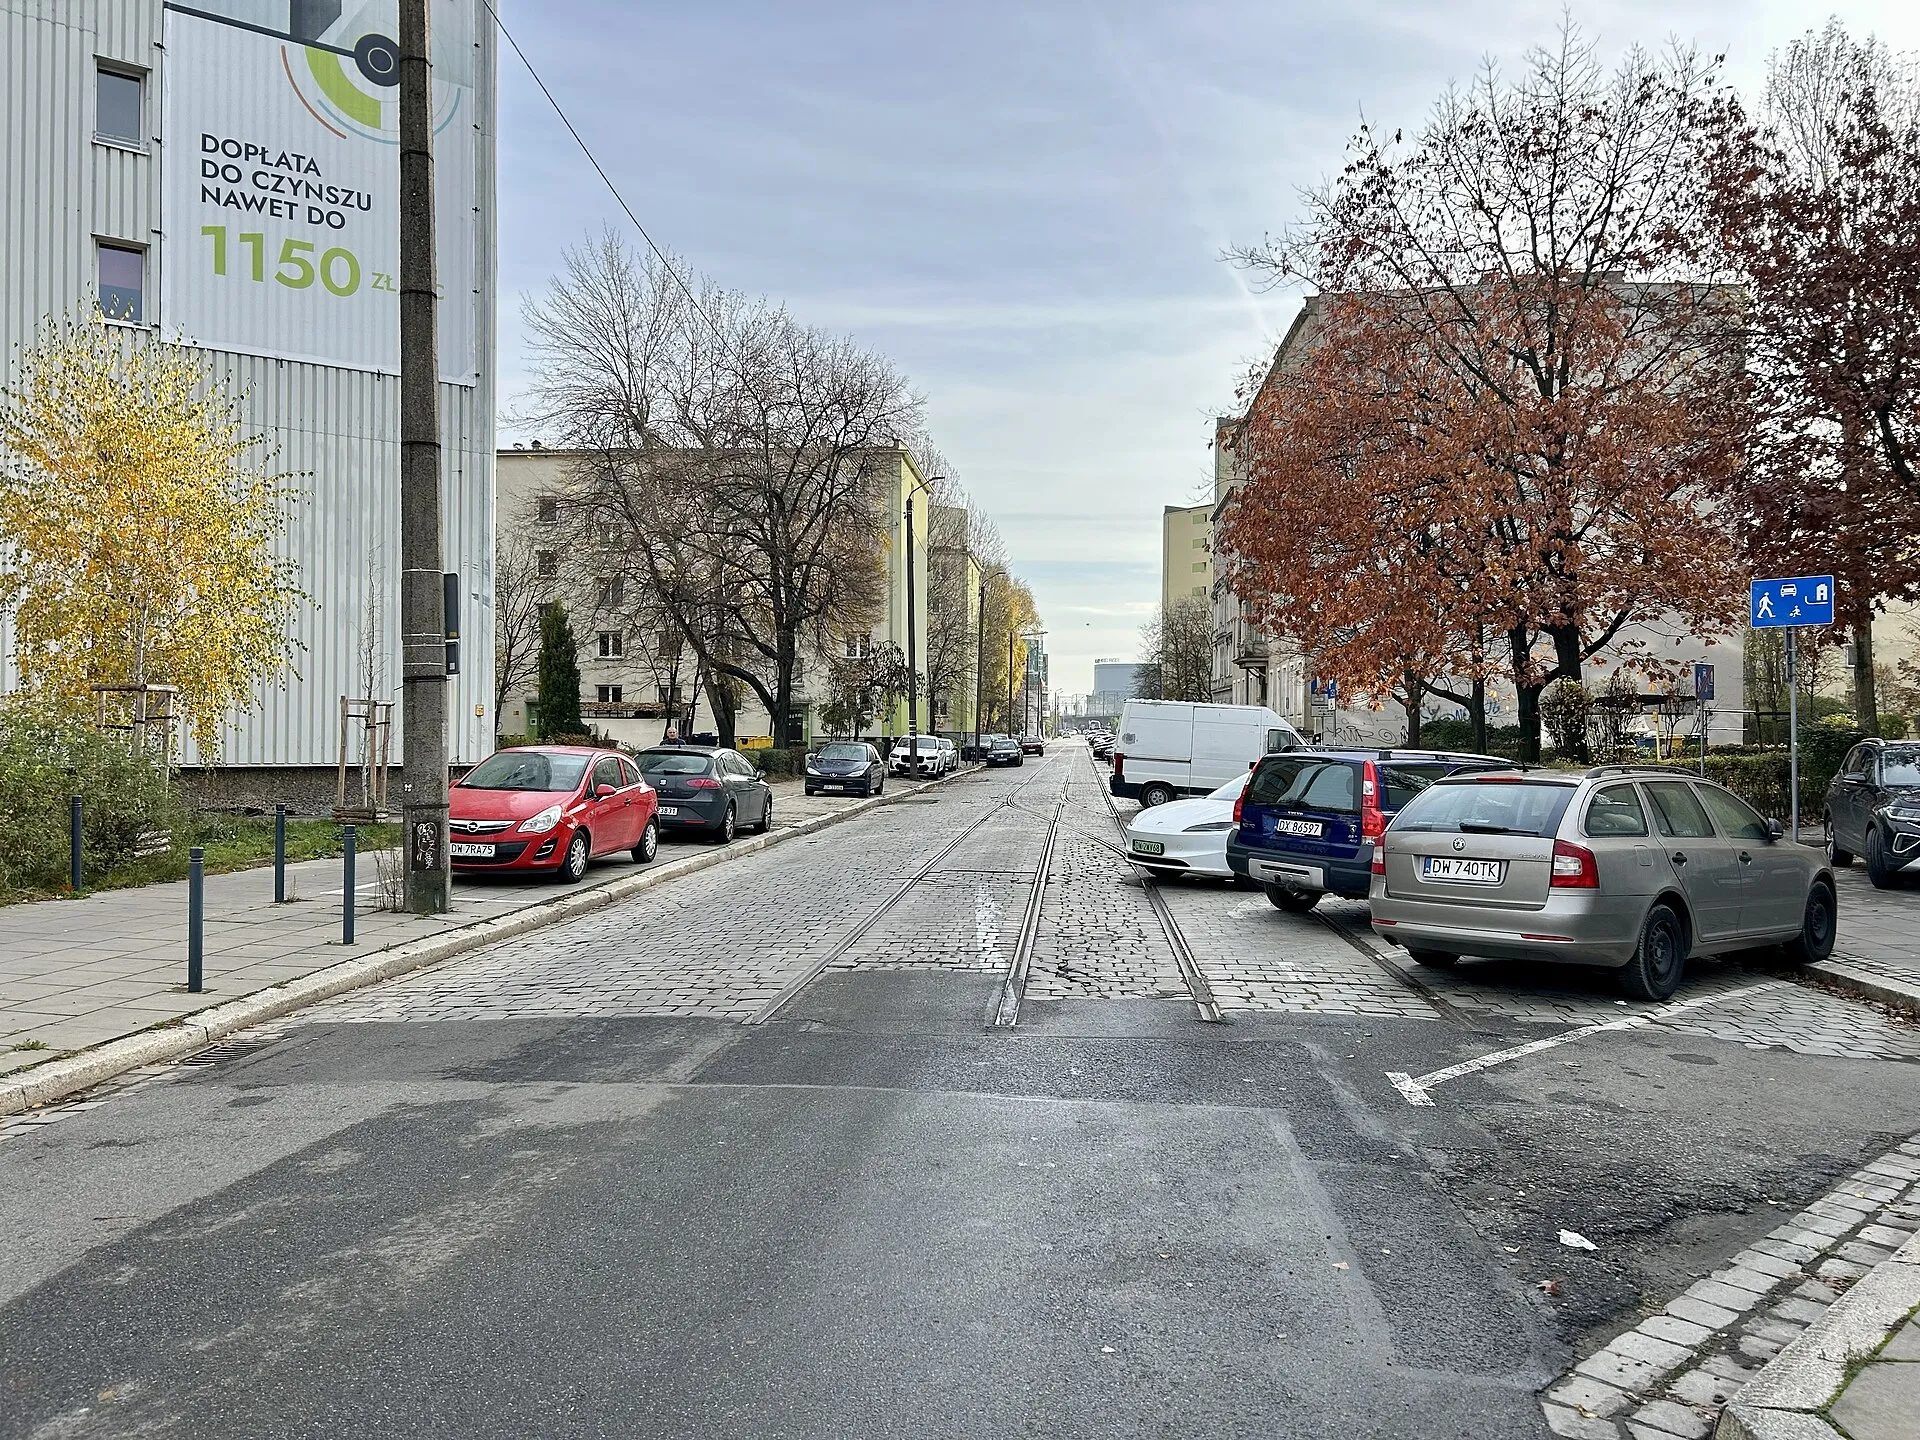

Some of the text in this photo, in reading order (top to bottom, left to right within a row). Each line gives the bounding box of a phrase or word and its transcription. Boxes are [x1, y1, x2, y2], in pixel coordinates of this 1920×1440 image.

[201, 132, 322, 178] DOPŁATA
[201, 158, 372, 212] DO CZYNSZU
[201, 184, 346, 230] NAWET DO
[200, 225, 361, 297] 1150
[451, 844, 493, 854] DW 7RA75
[1278, 820, 1320, 834] DX 86597
[1432, 859, 1497, 877] DW 740TK
